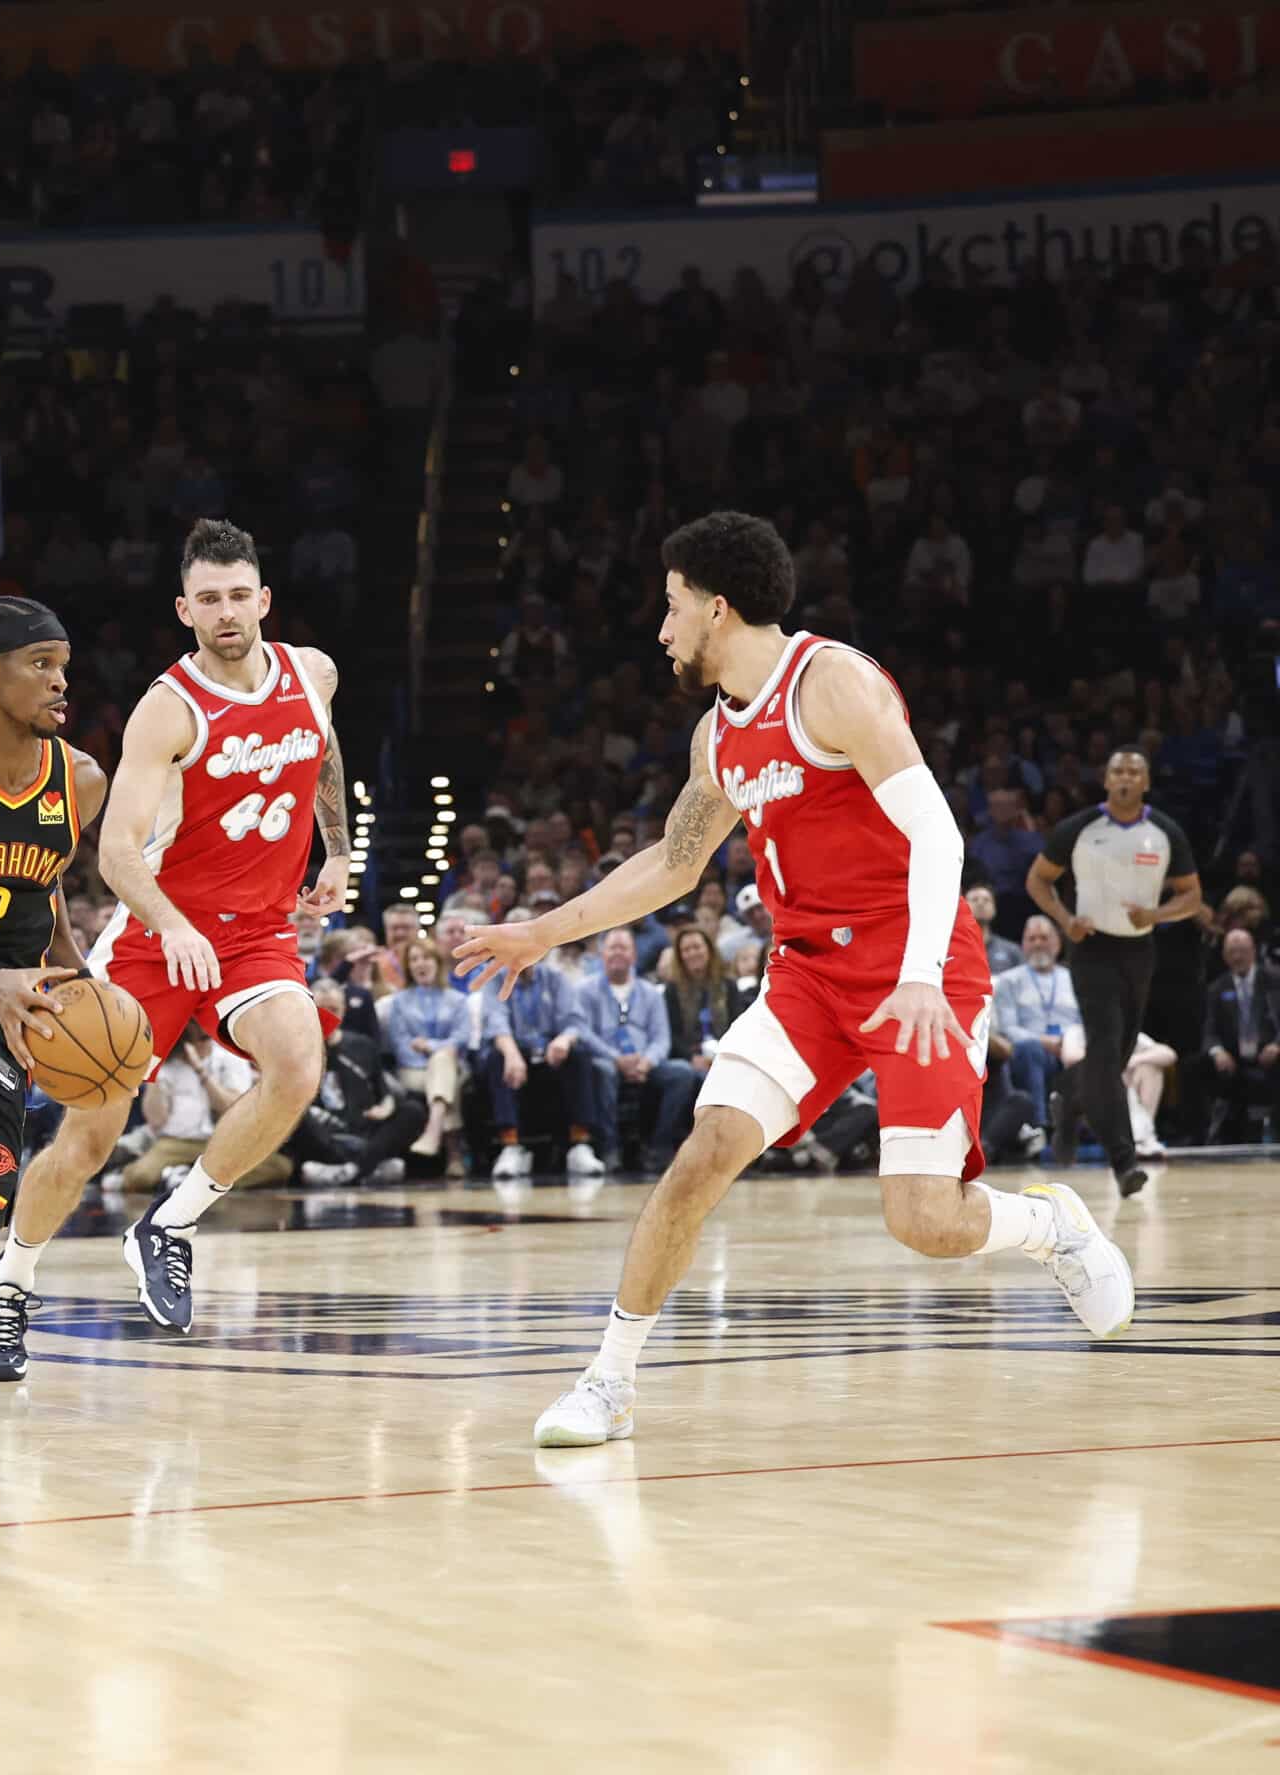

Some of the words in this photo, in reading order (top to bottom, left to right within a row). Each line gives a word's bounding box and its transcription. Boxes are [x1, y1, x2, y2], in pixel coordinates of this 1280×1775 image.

[206, 727, 320, 785] Memphis
[219, 792, 296, 842] 46
[764, 837, 786, 896] 1
